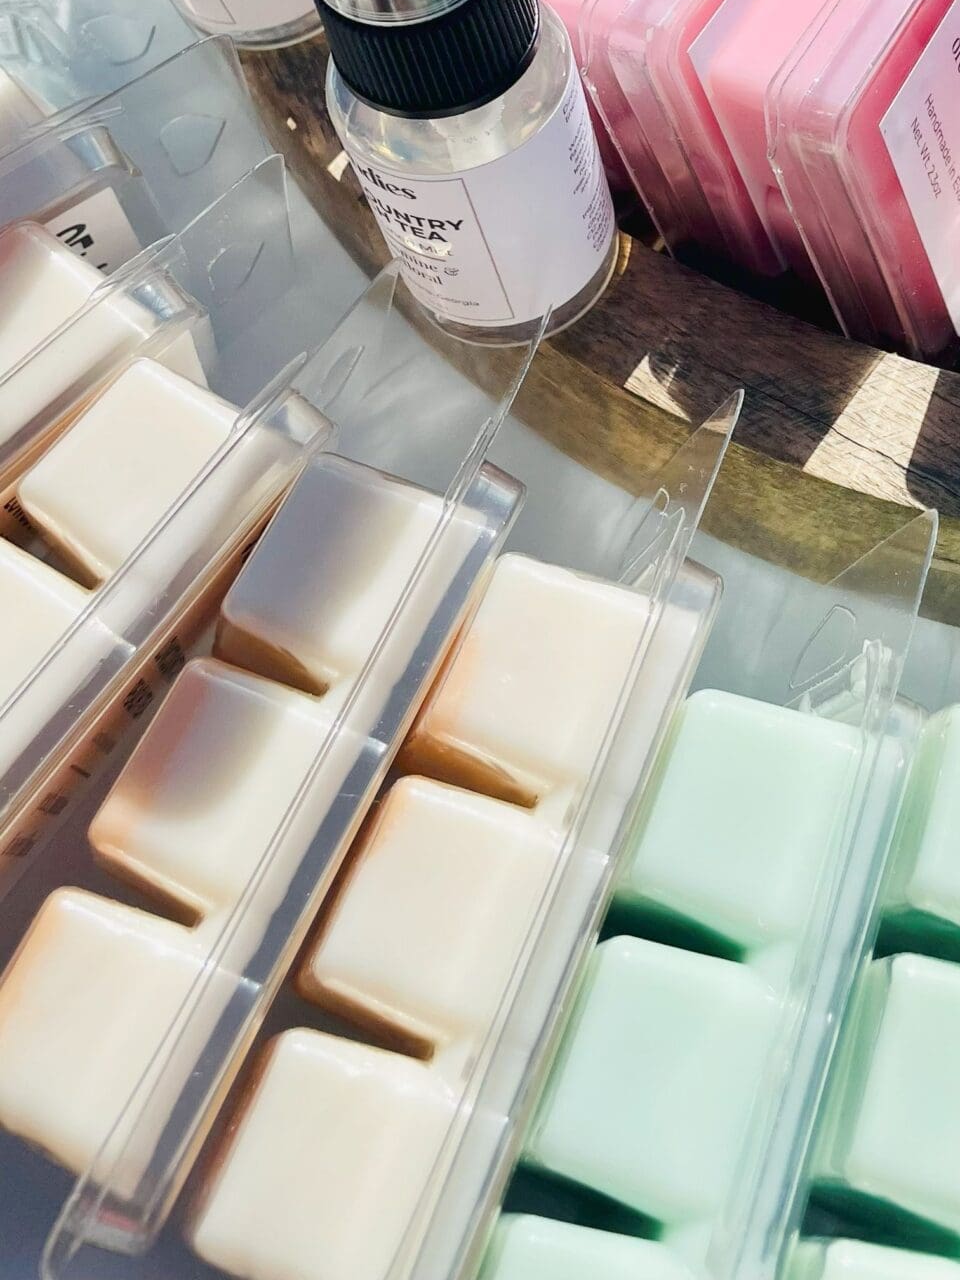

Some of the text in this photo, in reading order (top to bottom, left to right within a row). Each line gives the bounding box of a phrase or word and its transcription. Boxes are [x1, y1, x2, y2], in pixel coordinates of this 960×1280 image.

[924, 92, 953, 167] Handmade
[357, 165, 417, 200] dies
[364, 187, 464, 231] OUNTRY
[394, 218, 448, 243] TEA
